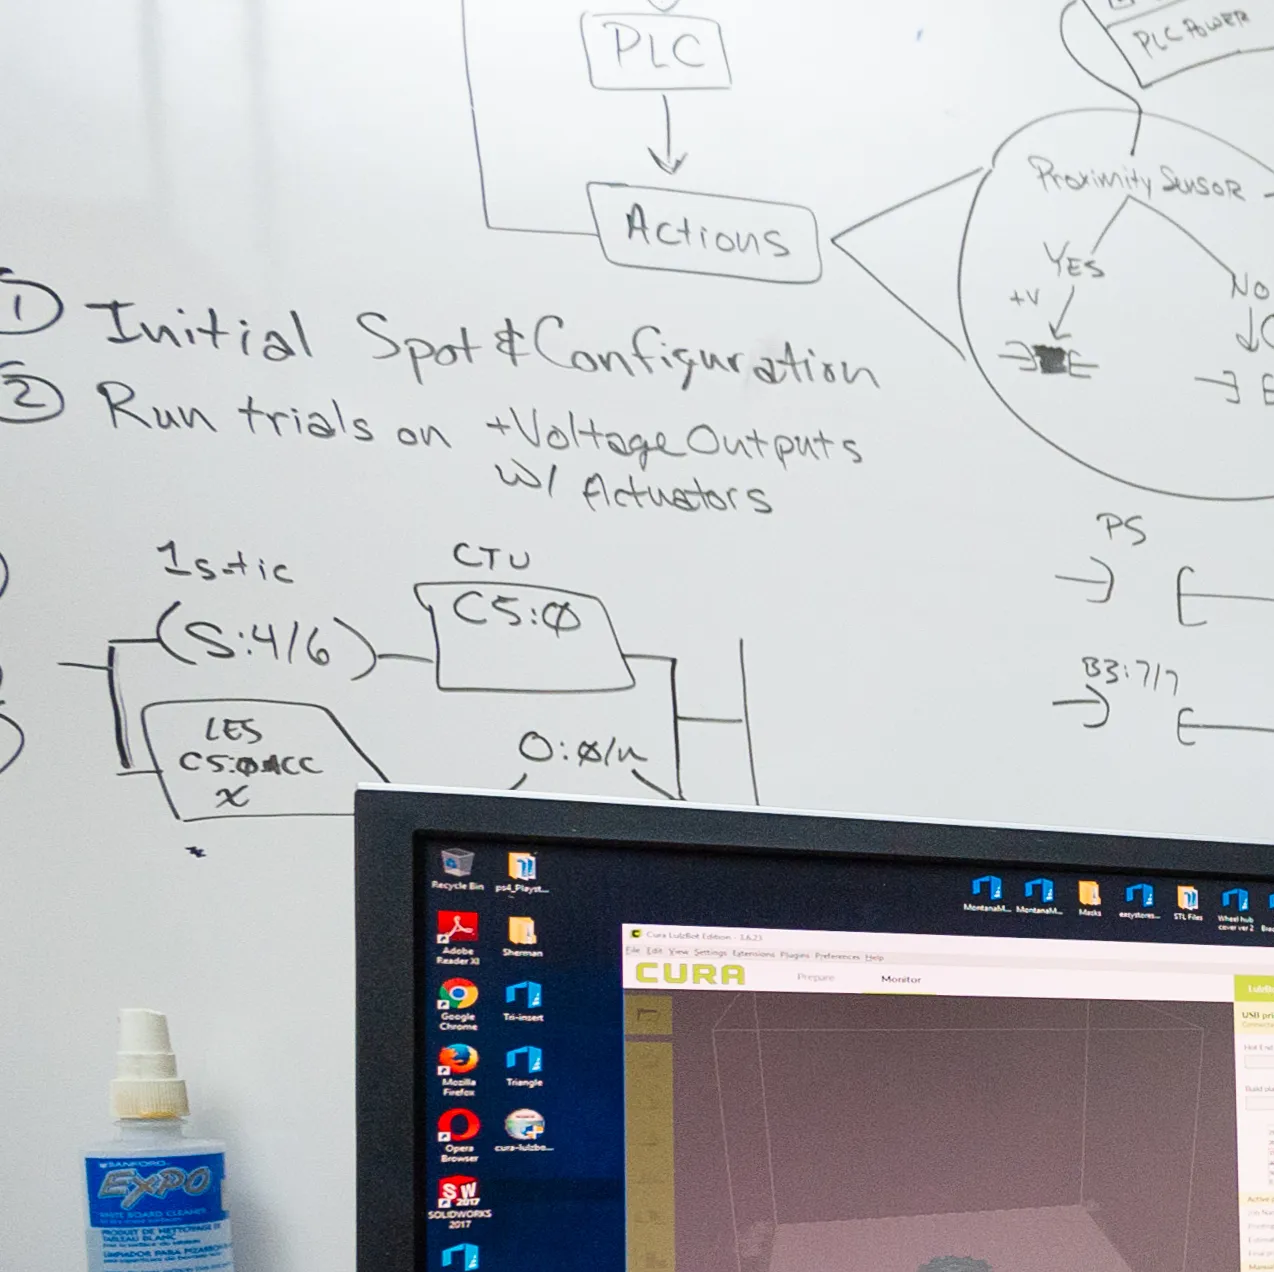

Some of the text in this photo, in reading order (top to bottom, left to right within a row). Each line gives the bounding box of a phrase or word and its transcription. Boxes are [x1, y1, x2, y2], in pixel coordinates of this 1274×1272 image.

[1133, 20, 1187, 59] PLC
[607, 20, 707, 71] PLC
[626, 204, 791, 260] Actions
[85, 299, 311, 362] Initial
[356, 310, 484, 386] Spot
[532, 312, 882, 392] Configuration
[96, 380, 217, 433] Run
[240, 396, 374, 444] trials
[398, 421, 452, 450] on
[583, 473, 774, 516] Actuators
[1097, 512, 1146, 546] PS
[452, 541, 530, 571] CTU
[431, 881, 485, 891] Recycle Bin
[442, 947, 544, 958] Adobe Sherman
[694, 949, 727, 958] Settings
[732, 949, 775, 958] Extensions
[815, 953, 860, 961] Preferences
[635, 962, 745, 985] CURA
[881, 974, 922, 984] Monitor
[441, 1012, 475, 1023] Google
[439, 1023, 478, 1031] Chrome
[442, 1078, 544, 1088] Mozilla Triangle
[443, 1088, 475, 1097] Firefox
[445, 1144, 474, 1154] Opera
[440, 1155, 479, 1163] Browser
[428, 1209, 492, 1220] SOLIDWORKS
[448, 1220, 472, 1229] 2017
